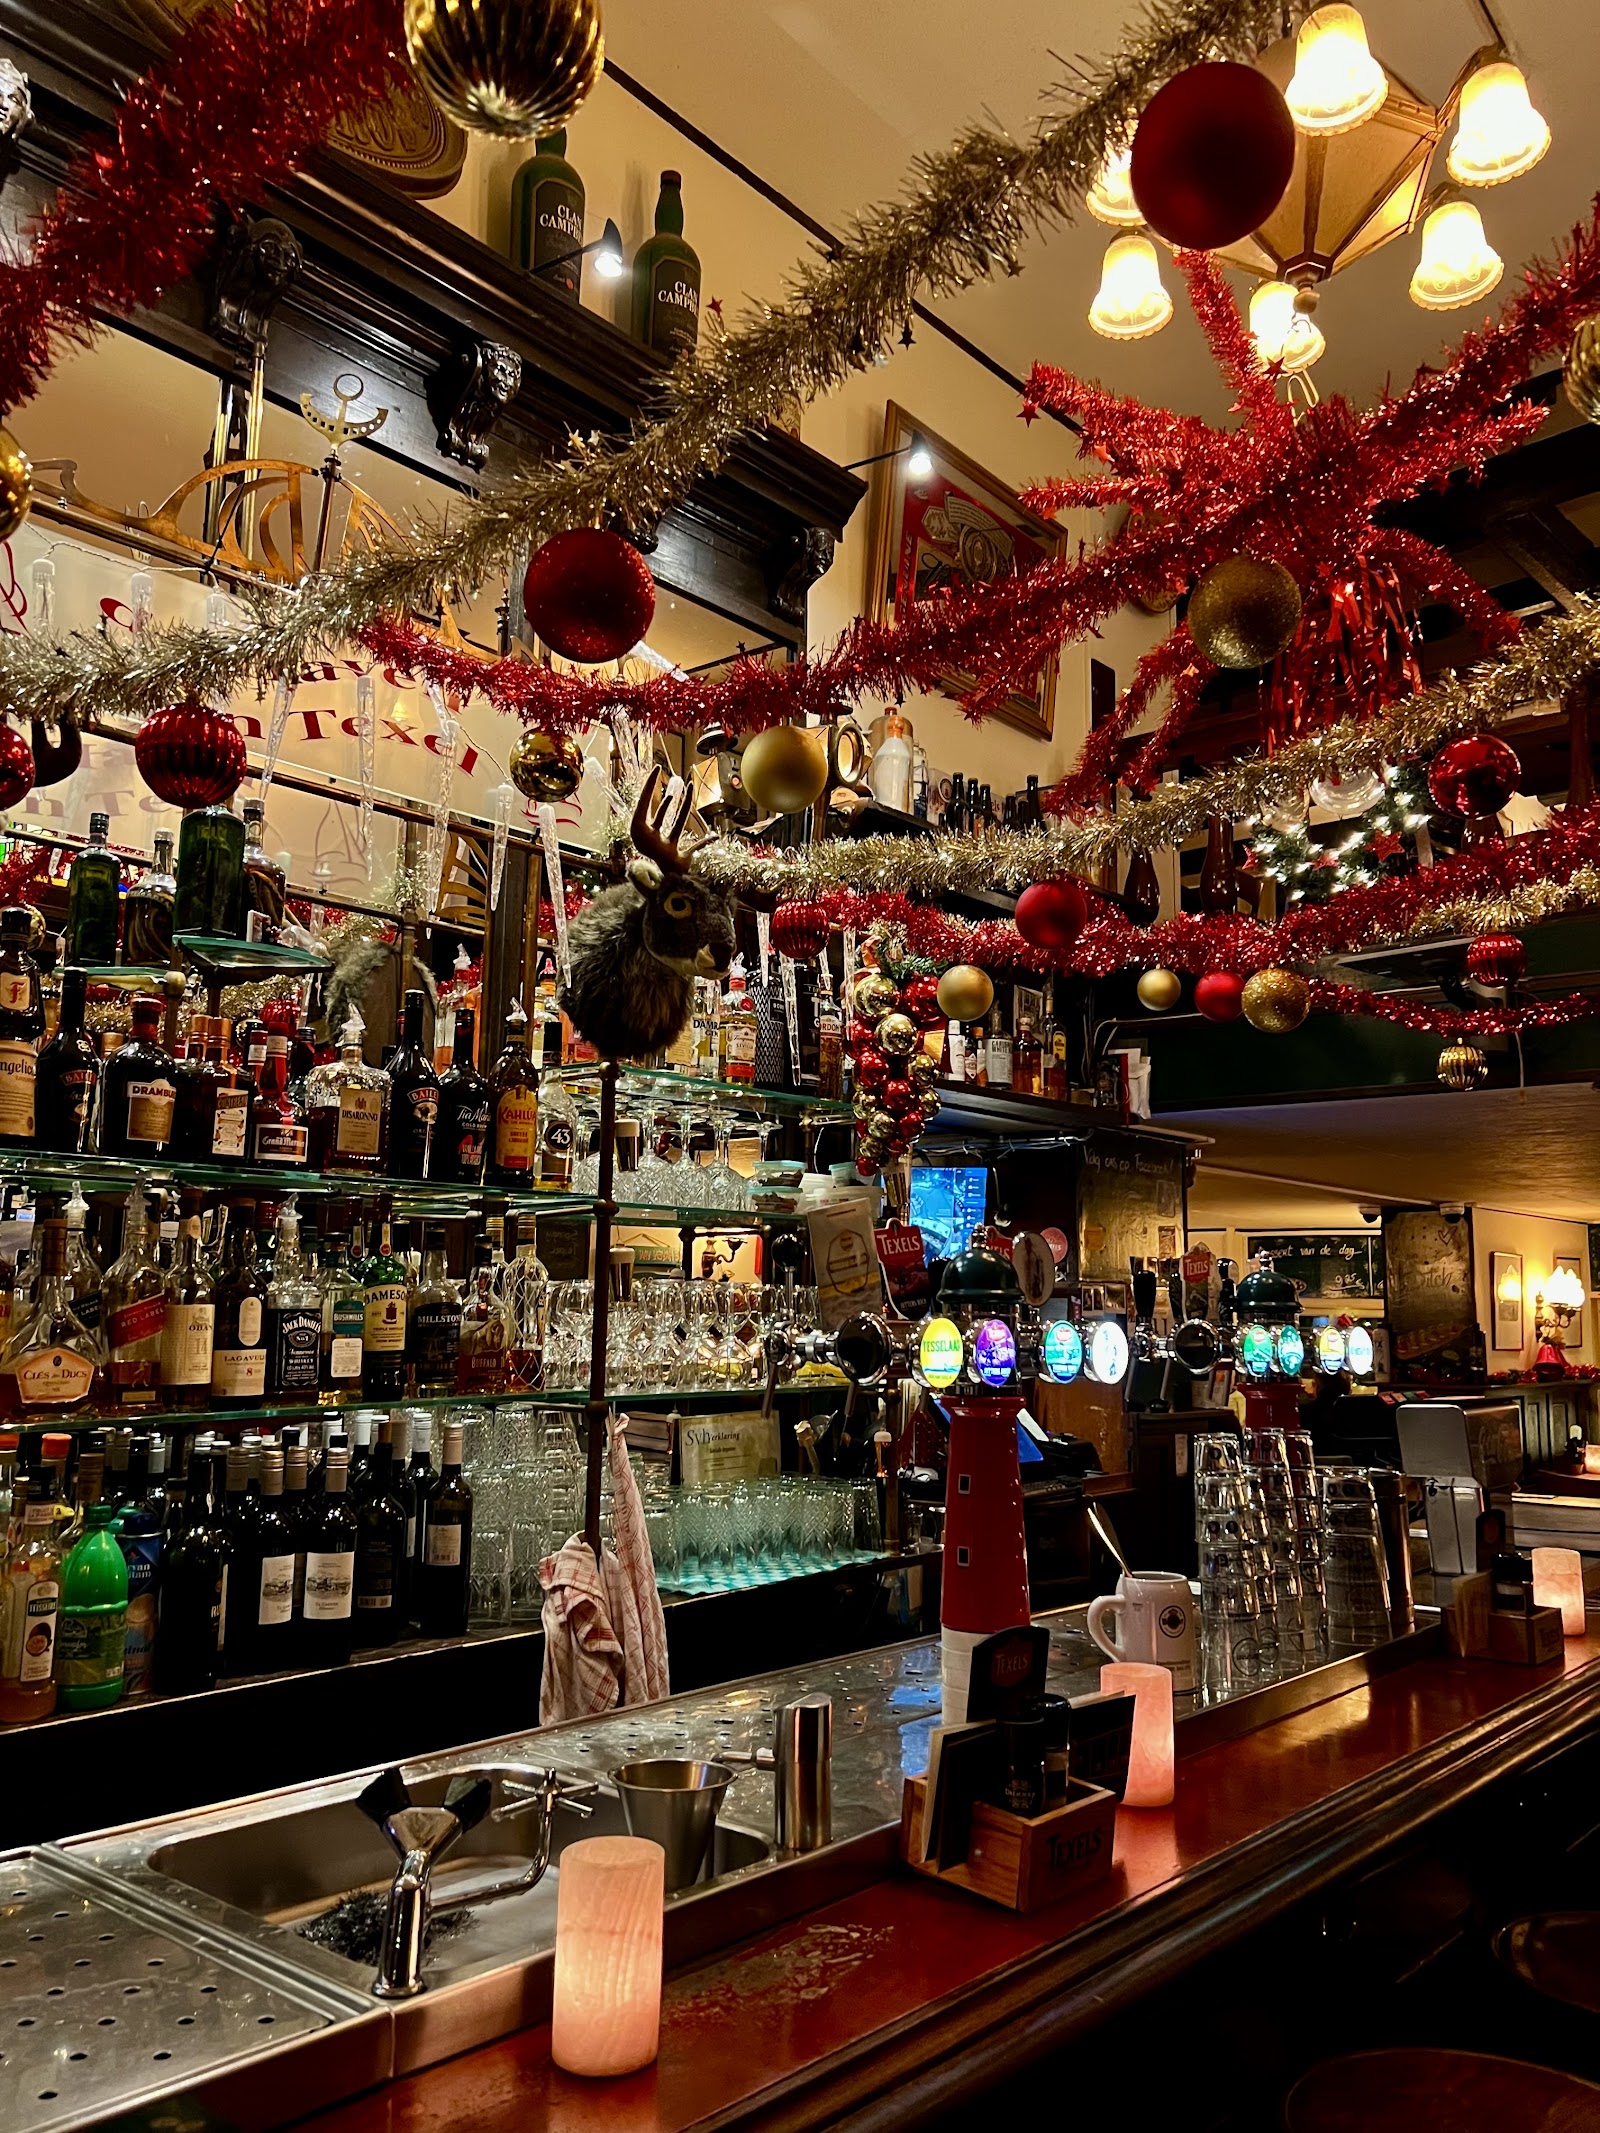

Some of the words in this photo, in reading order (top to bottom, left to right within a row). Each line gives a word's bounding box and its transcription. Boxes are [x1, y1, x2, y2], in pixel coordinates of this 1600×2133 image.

[288, 709, 479, 777] Texel
[342, 1110, 378, 1122] DISARONNO
[550, 1128, 571, 1145] 43
[877, 1234, 921, 1256] TEXELS
[1185, 1258, 1209, 1276] TEXELS
[140, 1308, 165, 1321] LABEL
[334, 1312, 363, 1321] BUSHMILLS
[282, 1319, 299, 1335] JACK
[995, 1652, 1029, 1680] TEXELS
